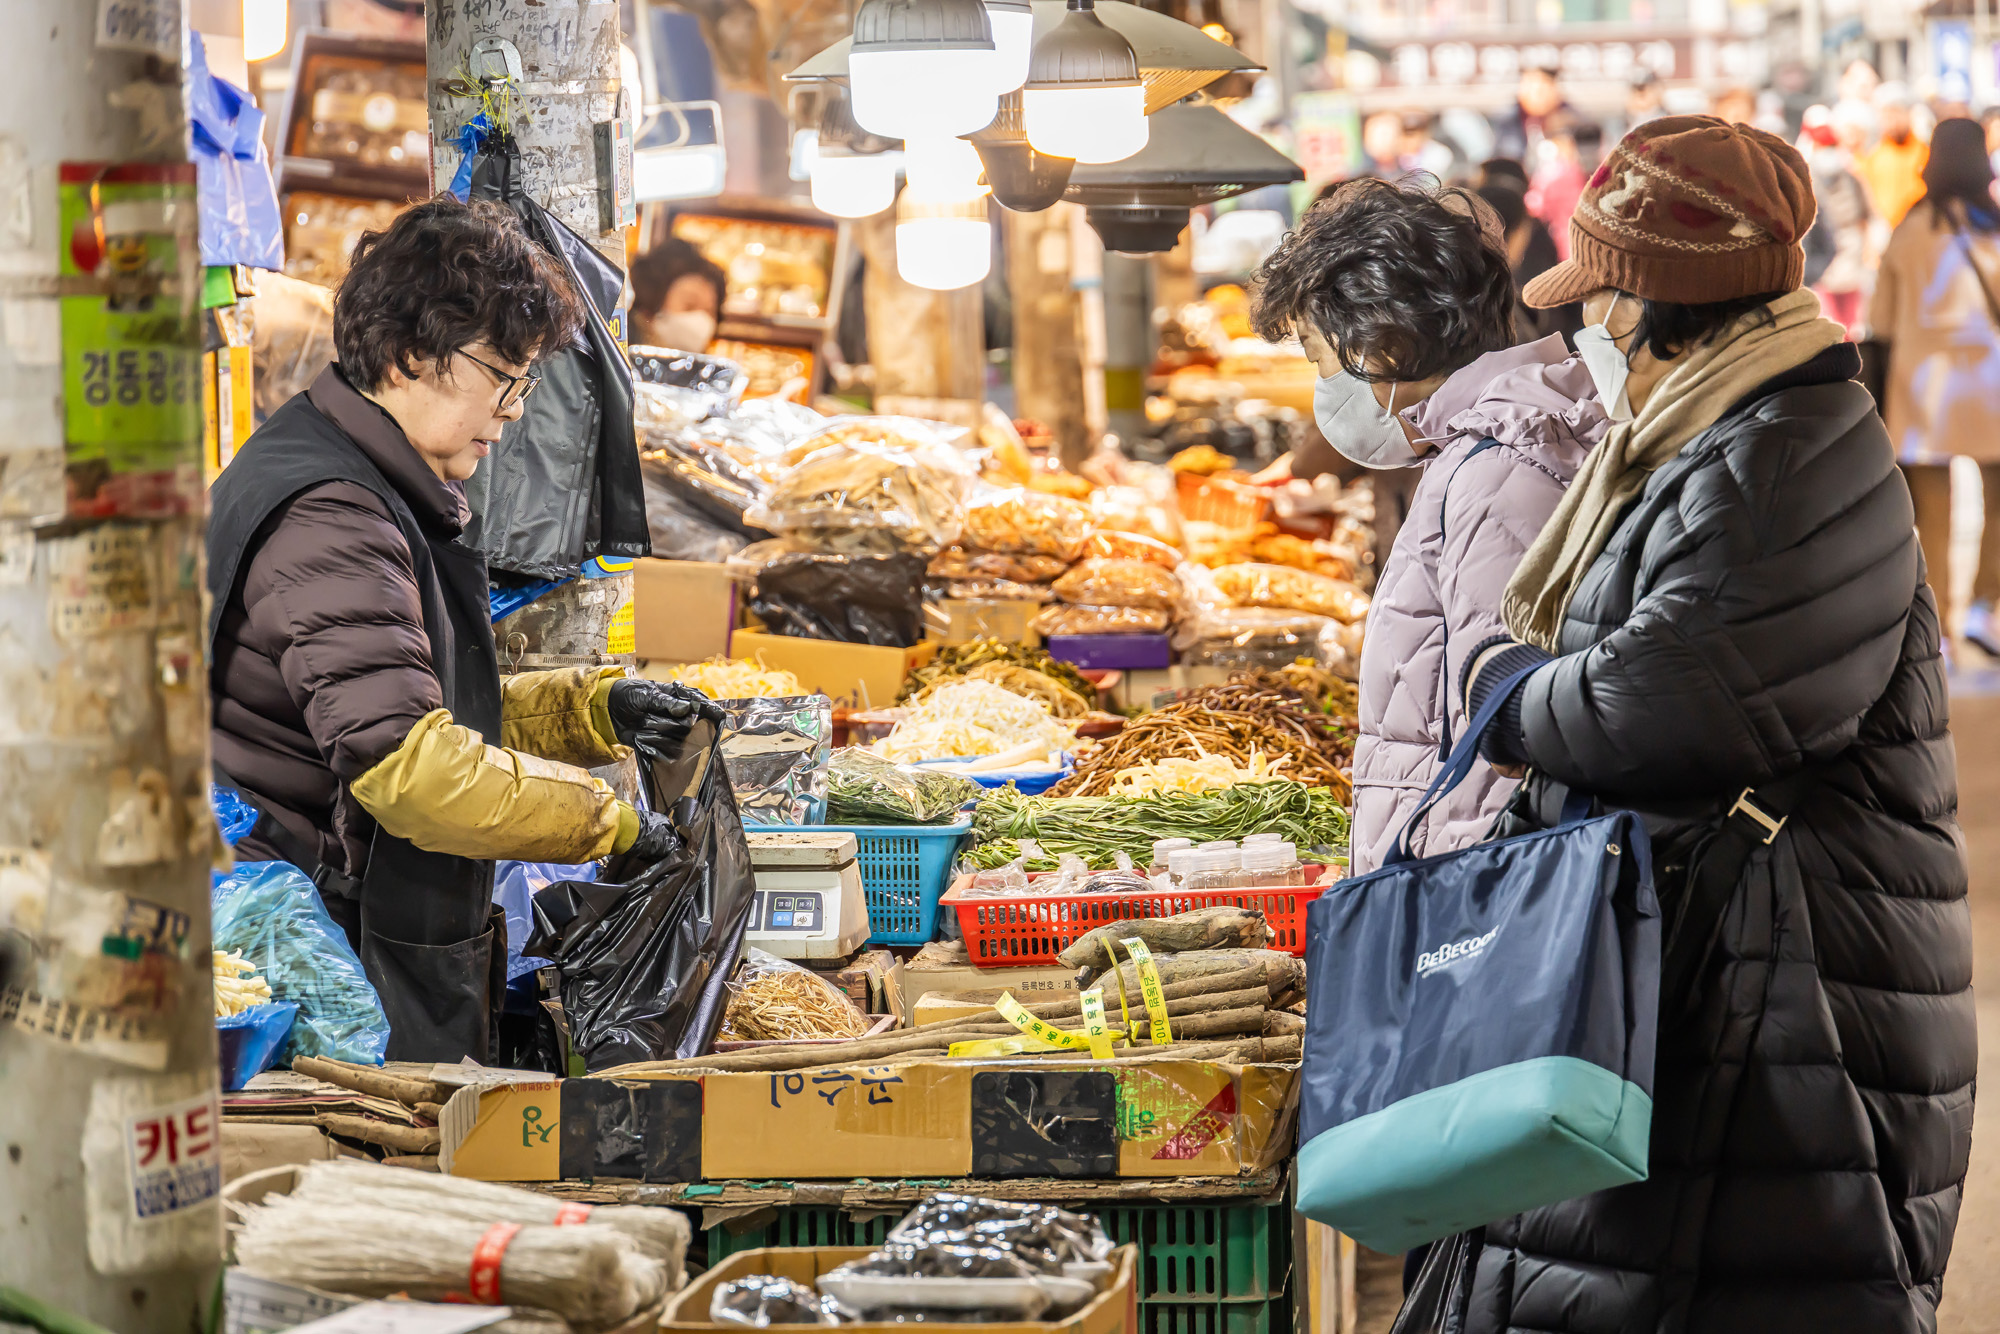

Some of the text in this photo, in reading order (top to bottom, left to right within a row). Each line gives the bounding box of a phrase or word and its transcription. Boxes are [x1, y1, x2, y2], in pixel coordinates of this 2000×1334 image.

[1021, 980, 1055, 991] 등록번호
[1063, 979, 1072, 990] 제
[1142, 975, 1169, 1046] 김동범 010-
[135, 1106, 212, 1166] 카드
[522, 1106, 558, 1147] 성
